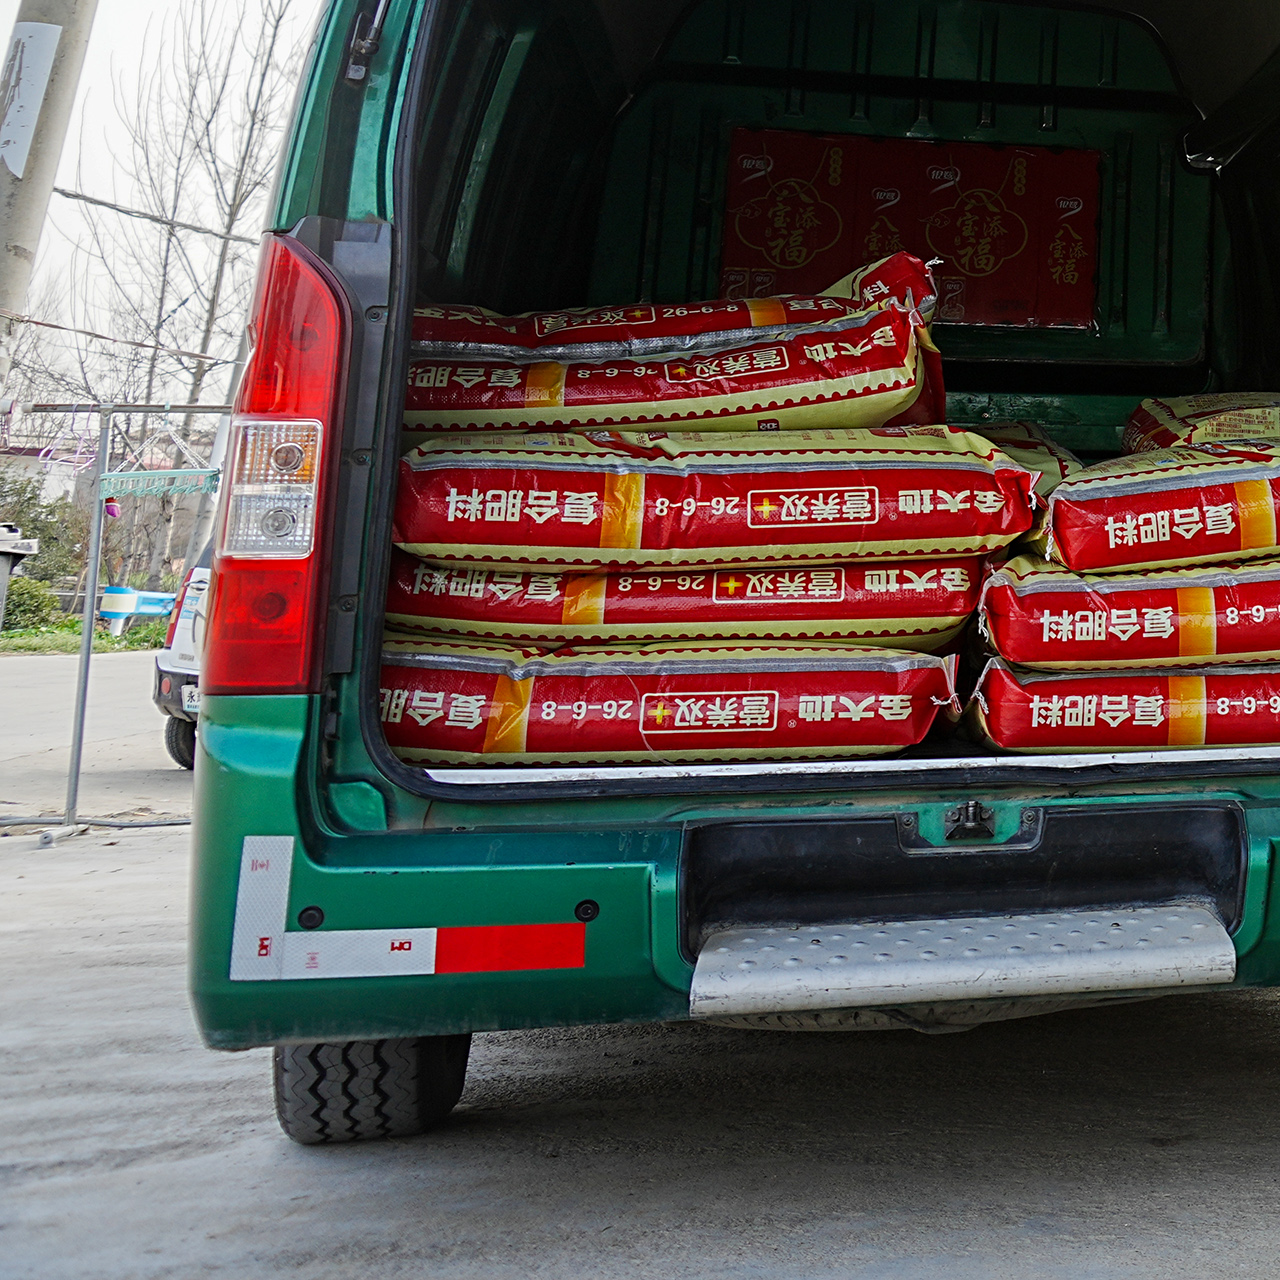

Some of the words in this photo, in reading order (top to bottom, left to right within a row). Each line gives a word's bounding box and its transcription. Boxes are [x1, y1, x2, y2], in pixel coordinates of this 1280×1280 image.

[407, 366, 523, 389] 复合肥
[445, 487, 600, 526] 复合肥料
[655, 496, 740, 517] 26-6-8
[898, 488, 1007, 515] 金大地
[1103, 503, 1237, 549] 复合肥料
[413, 563, 563, 601] 复合肥料
[618, 574, 706, 592] 26-6-8
[865, 567, 972, 593] 金大地
[1039, 606, 1176, 643] 复合肥料
[540, 699, 635, 721] 26-6-8
[798, 694, 914, 722] 金大地
[1029, 694, 1166, 729] 复合肥料
[257, 936, 270, 957] DM
[390, 940, 412, 951] DM
